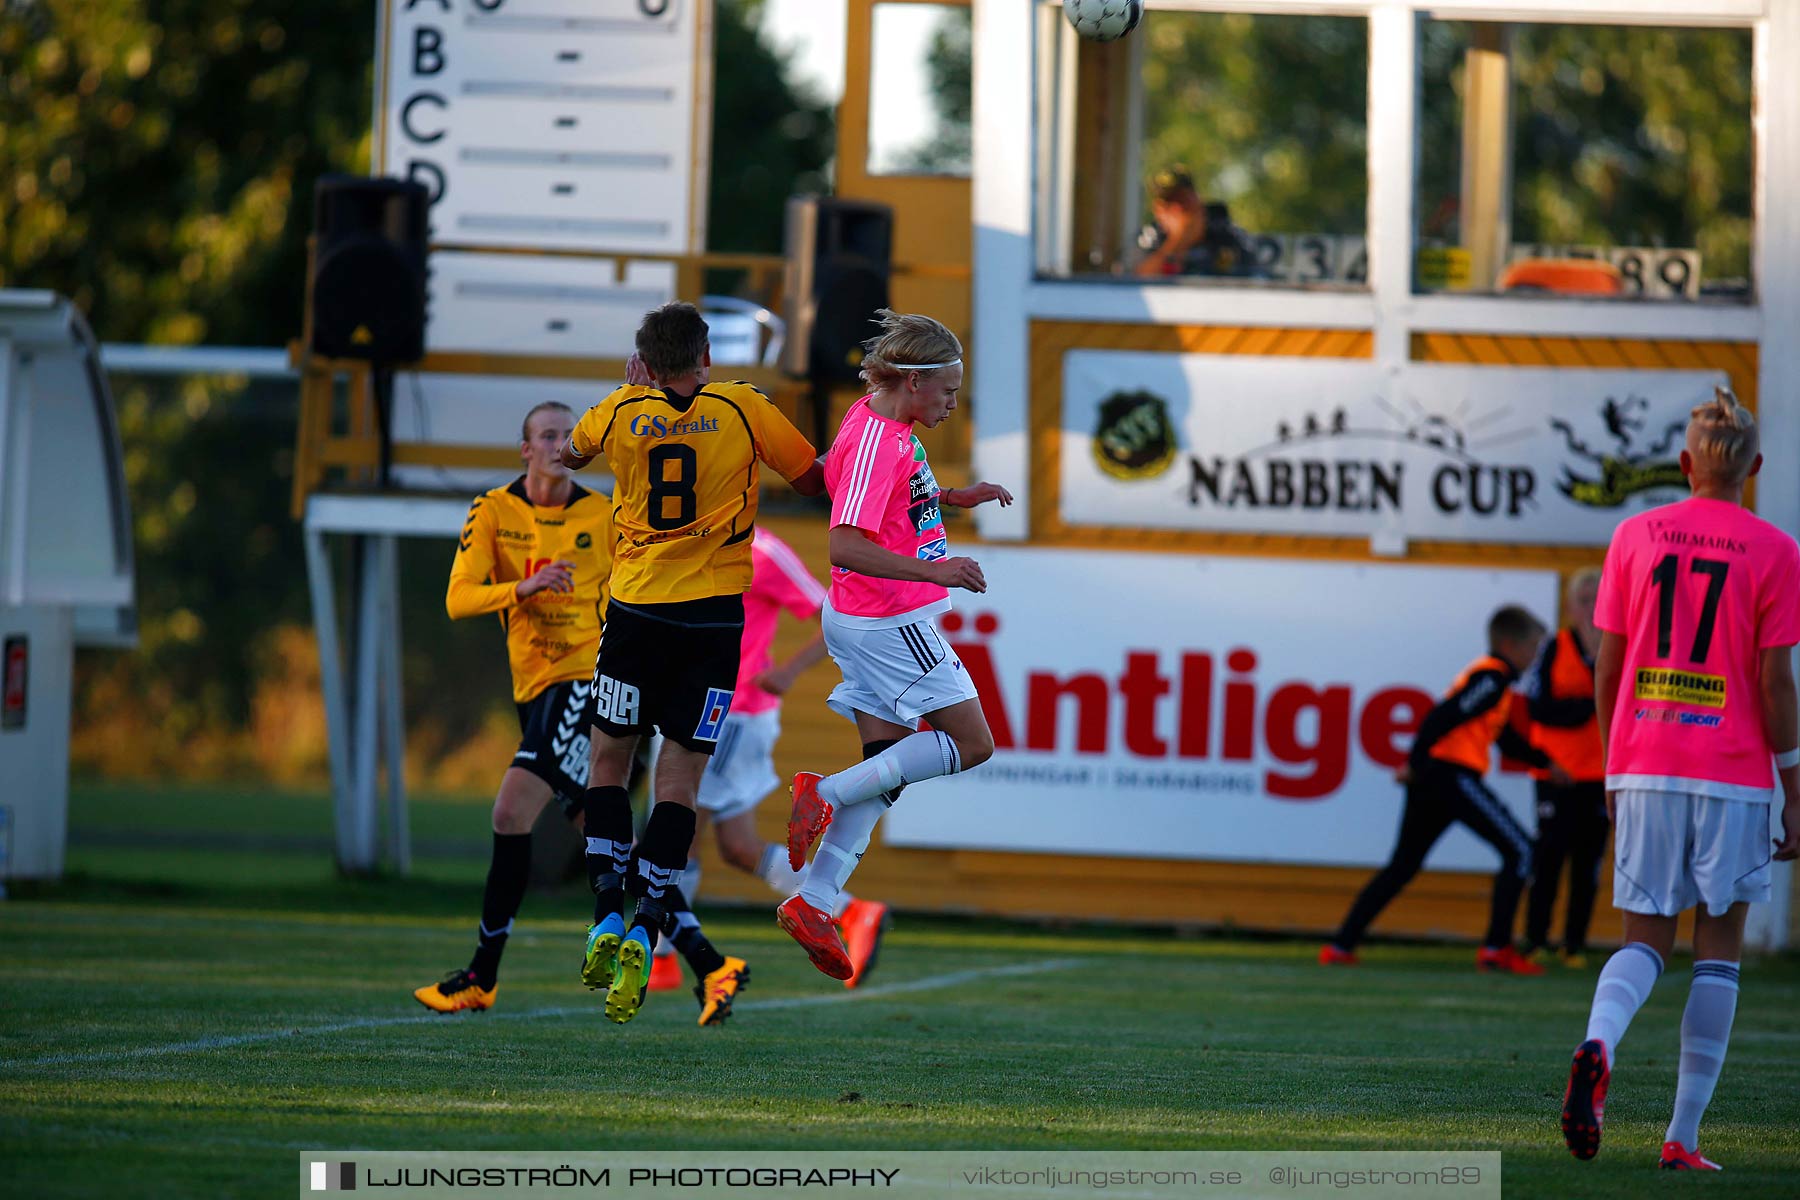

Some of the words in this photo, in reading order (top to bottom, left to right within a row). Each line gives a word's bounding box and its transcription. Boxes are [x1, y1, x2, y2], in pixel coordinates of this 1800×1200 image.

[413, 27, 445, 76] B
[401, 93, 446, 144] C
[648, 443, 696, 531] 8
[1187, 456, 1404, 512] NABBEN
[1430, 462, 1536, 517] CUP
[1652, 553, 1730, 665] 17
